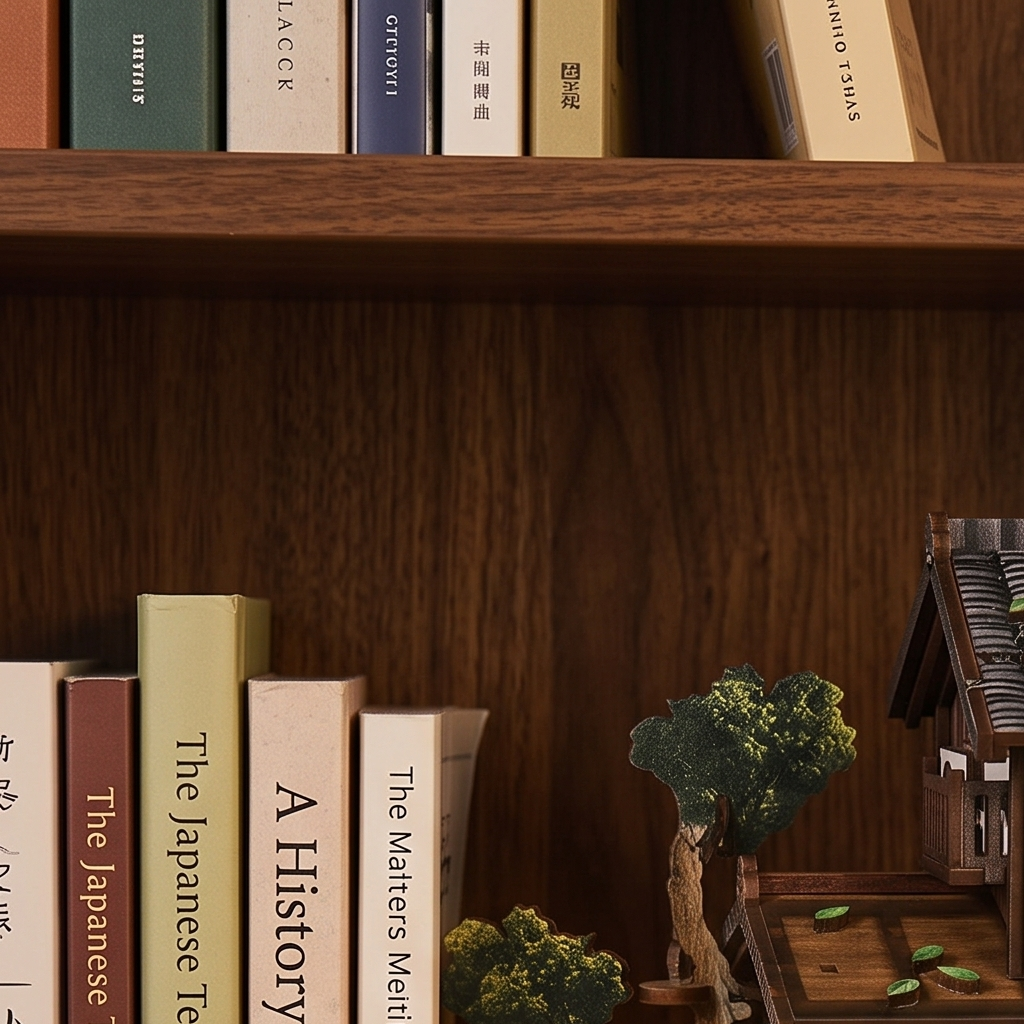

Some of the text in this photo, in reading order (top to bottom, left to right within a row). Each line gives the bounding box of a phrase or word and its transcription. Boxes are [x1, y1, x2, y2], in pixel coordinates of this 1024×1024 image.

[177, 732, 208, 800] The
[276, 782, 317, 822] A
[389, 767, 414, 819] The
[87, 787, 115, 847] The
[167, 813, 207, 972] Japanese
[388, 833, 412, 939] Matters
[80, 860, 115, 1005] Japanese
[262, 839, 318, 1024] History
